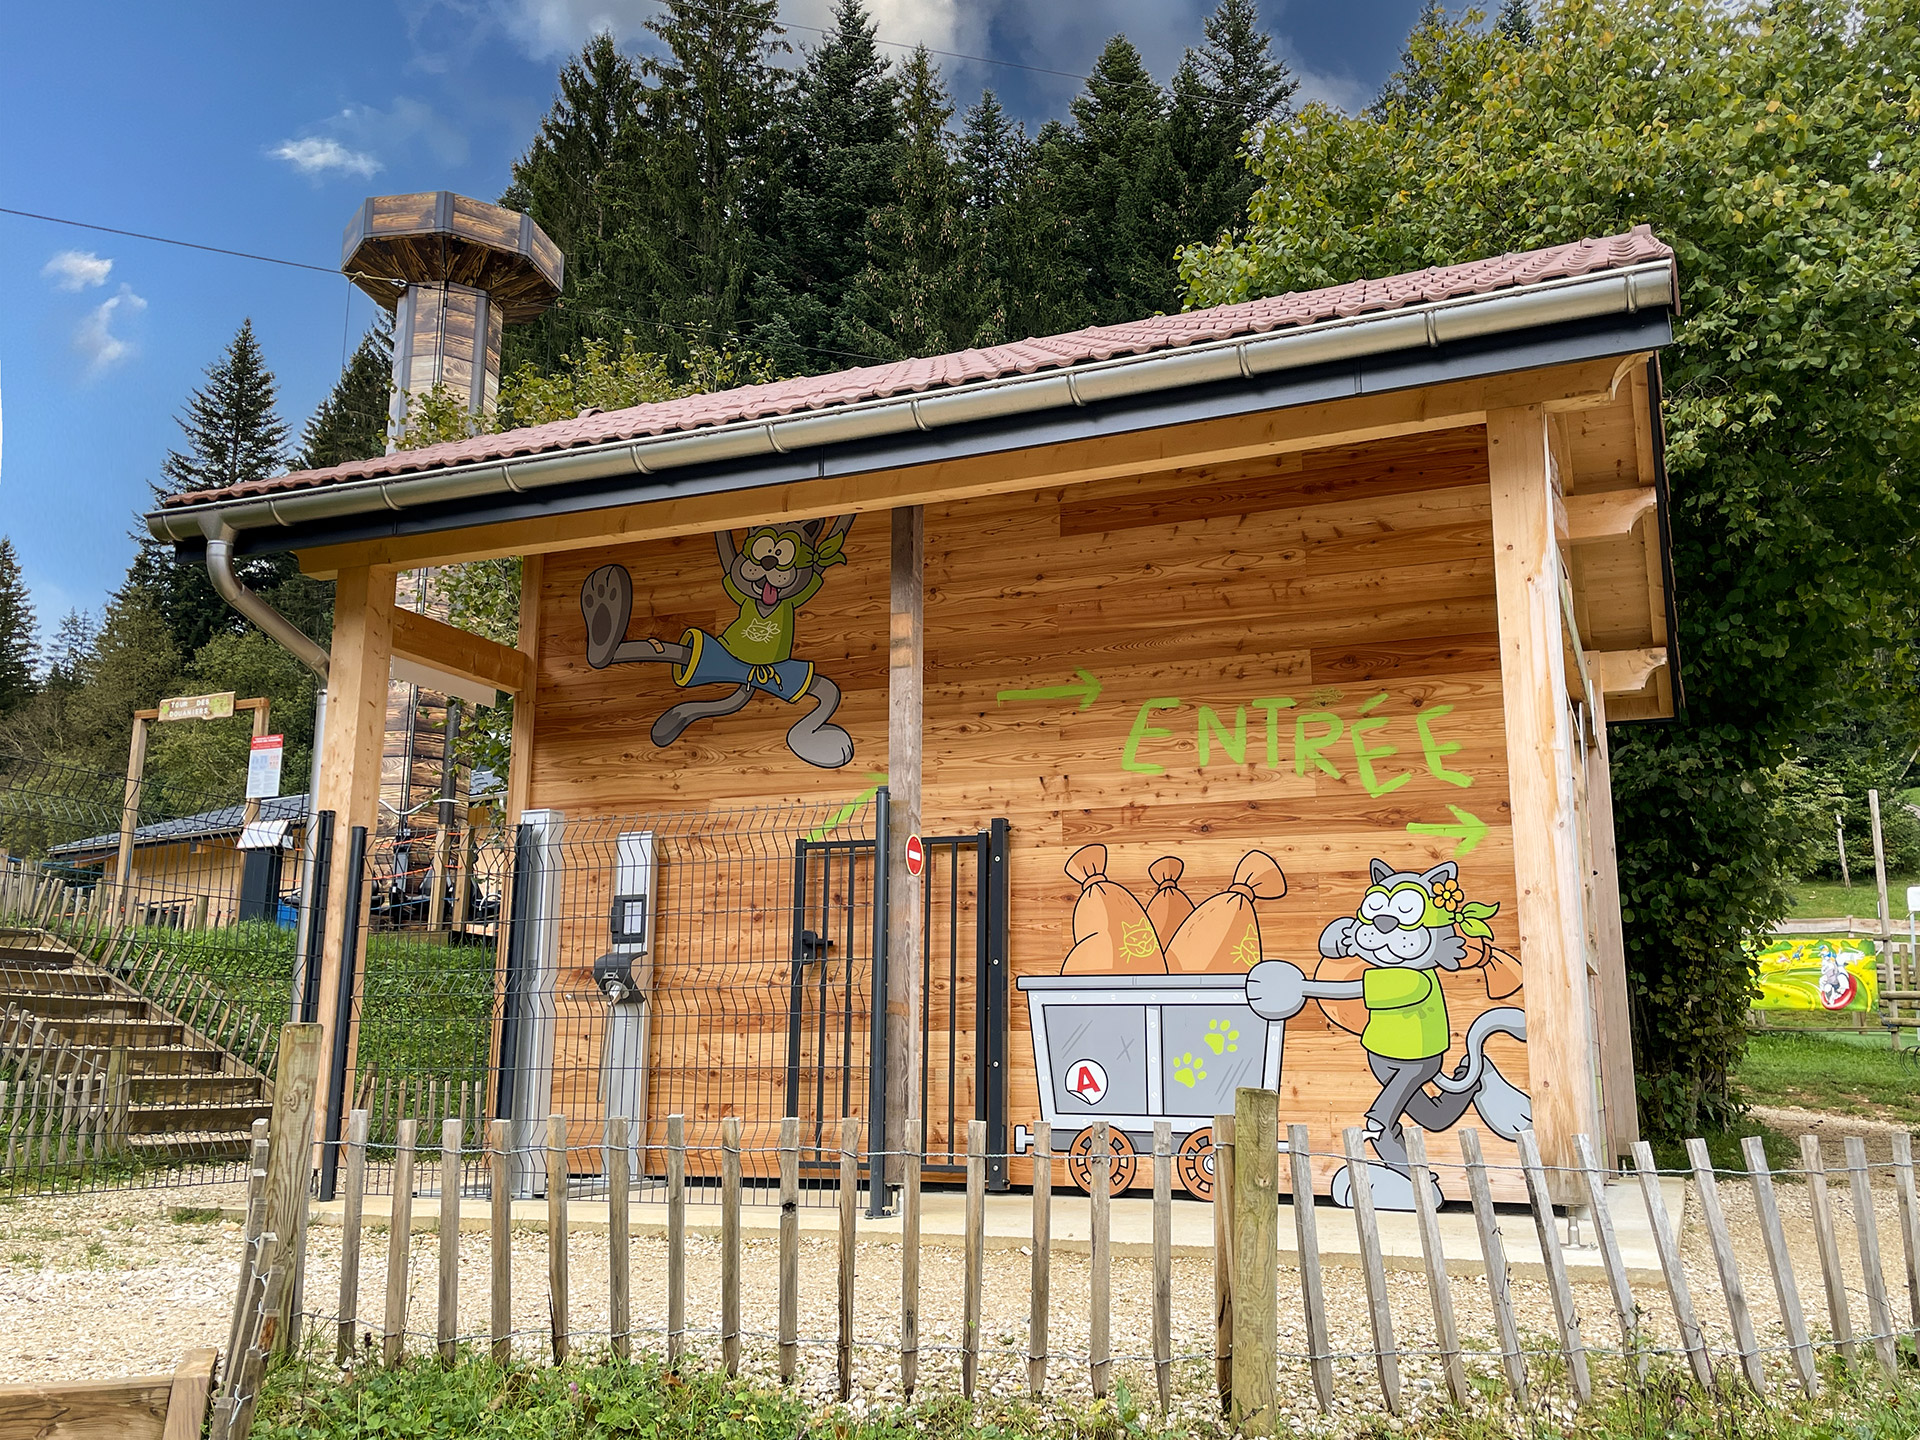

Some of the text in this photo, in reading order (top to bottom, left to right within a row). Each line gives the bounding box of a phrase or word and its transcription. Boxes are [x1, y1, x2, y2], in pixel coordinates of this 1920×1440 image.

[196, 698, 210, 706] DES
[169, 707, 209, 718] DOUANIERS
[1121, 693, 1474, 799] ENTRÉE
[1076, 1066, 1101, 1093] A
